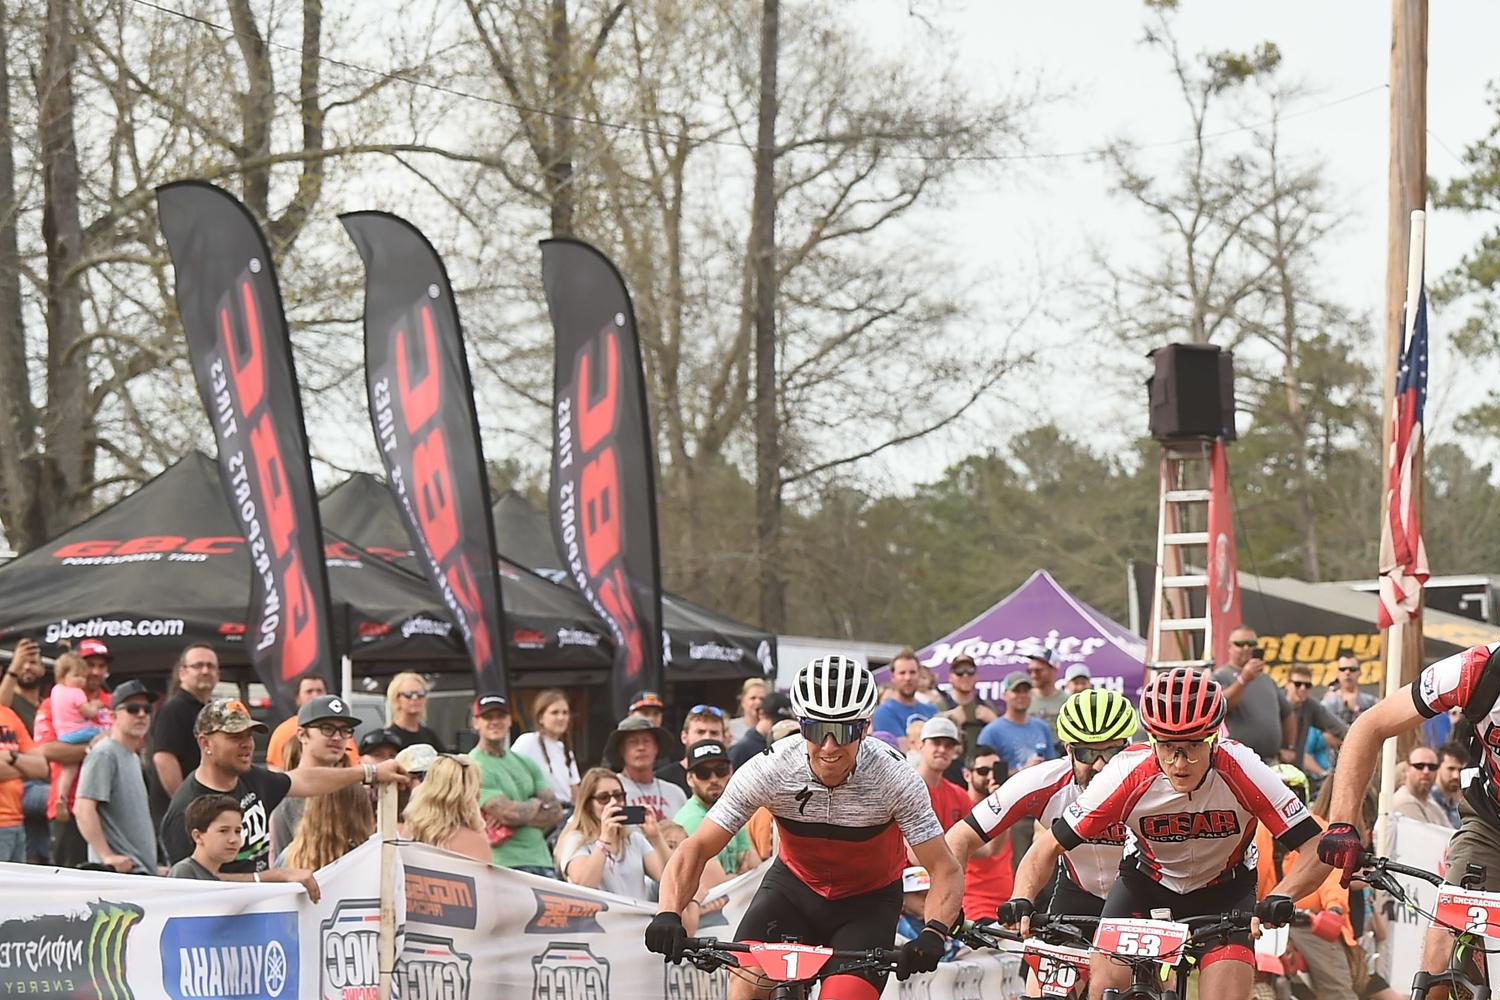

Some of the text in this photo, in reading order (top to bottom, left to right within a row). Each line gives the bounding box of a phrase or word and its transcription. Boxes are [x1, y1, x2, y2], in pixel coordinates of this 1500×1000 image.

[52, 533, 246, 558] GBC
[45, 617, 185, 643] gbctires.com
[920, 629, 1067, 668] Hoosier
[1143, 811, 1236, 837] GEAR
[1465, 905, 1489, 933] 3
[1116, 932, 1162, 958] 53
[782, 950, 799, 980] 1
[1037, 957, 1078, 989] 50
